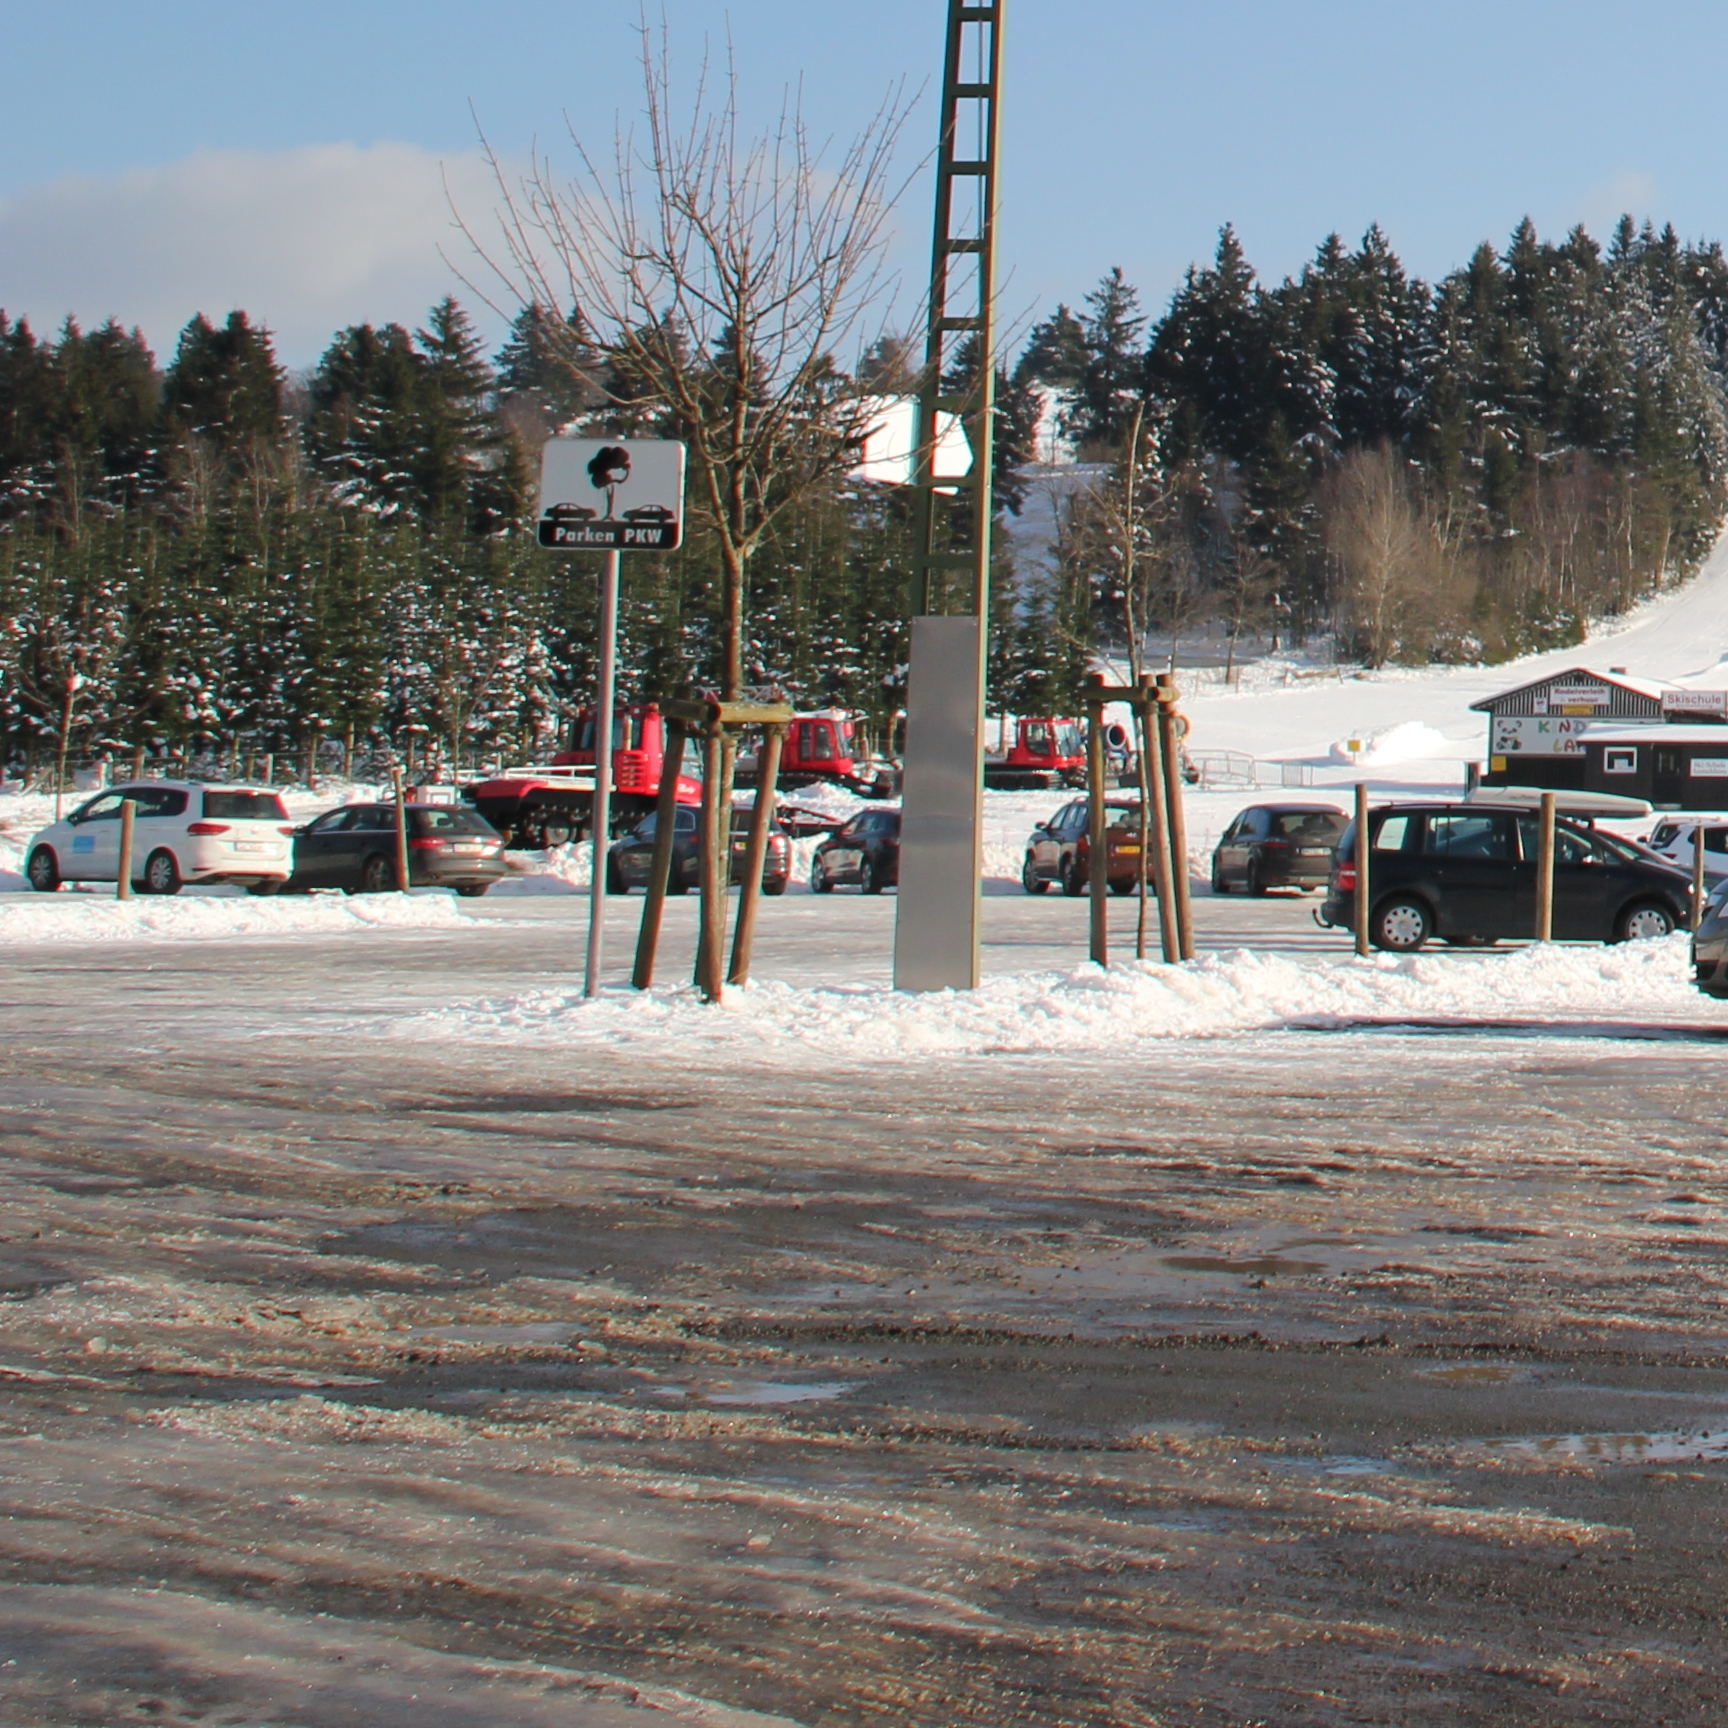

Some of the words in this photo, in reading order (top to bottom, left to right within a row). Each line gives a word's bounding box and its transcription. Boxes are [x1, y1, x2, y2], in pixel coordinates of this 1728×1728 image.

[554, 526, 615, 543] Parken
[623, 528, 663, 544] PKW
[1667, 694, 1722, 704] Skischule
